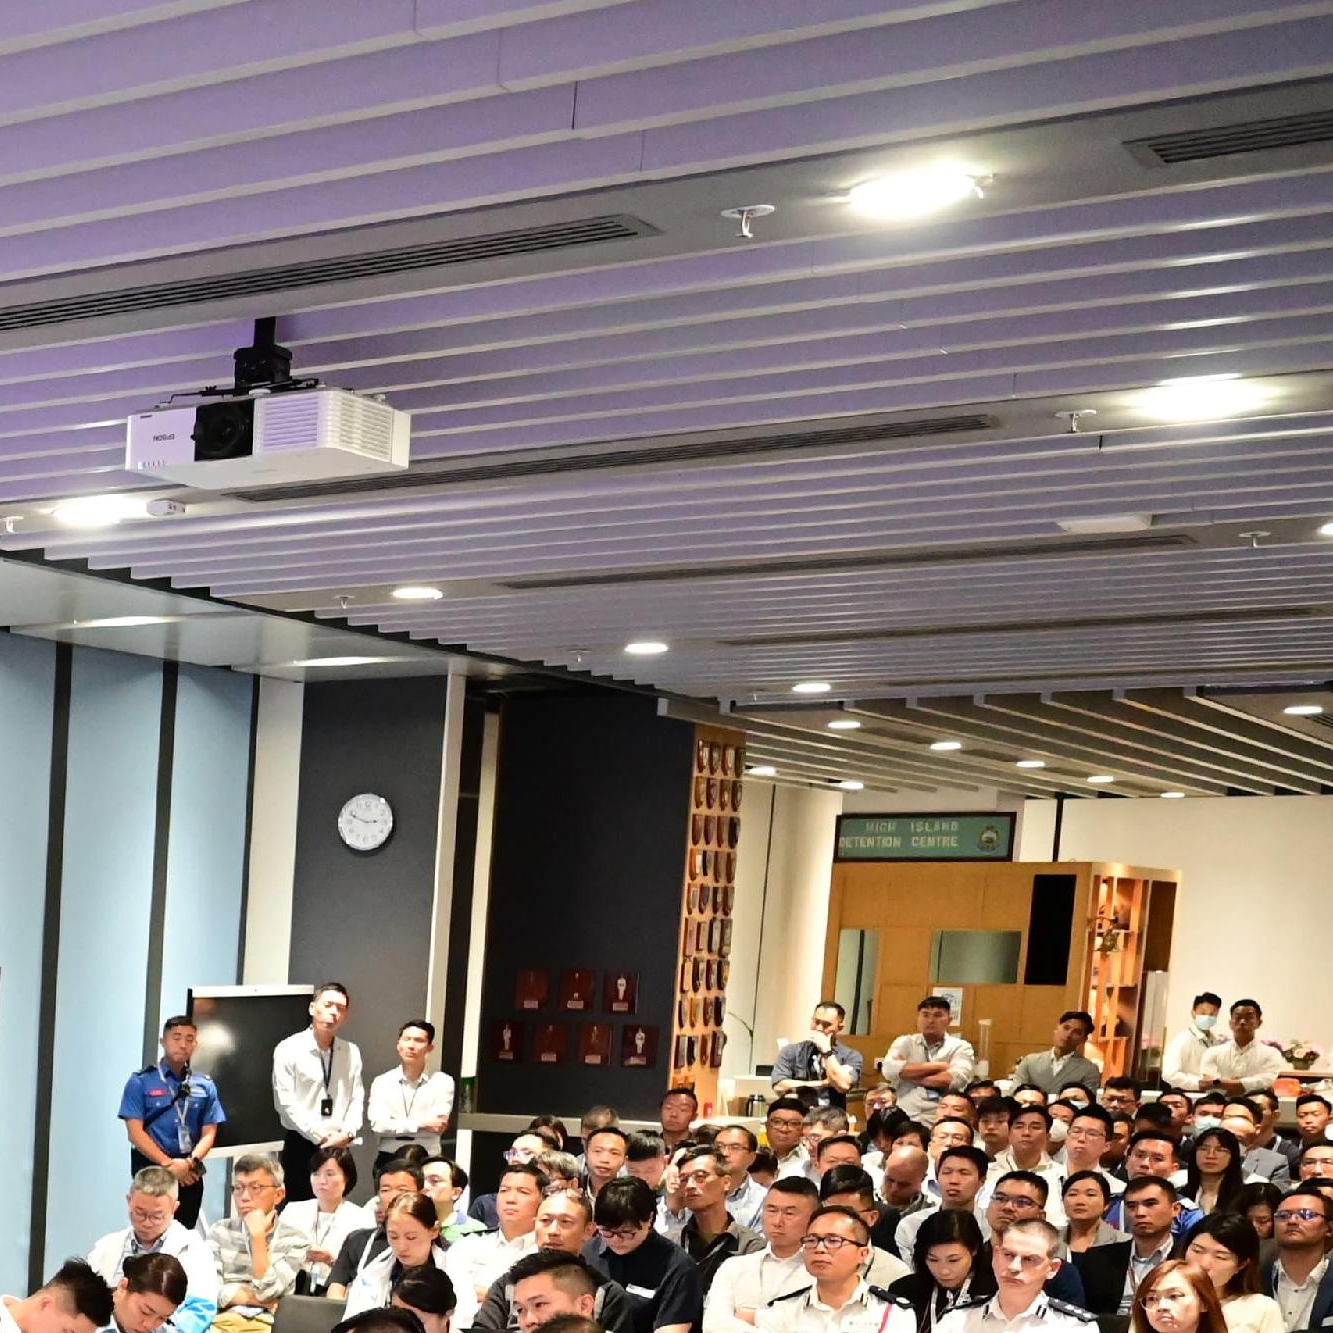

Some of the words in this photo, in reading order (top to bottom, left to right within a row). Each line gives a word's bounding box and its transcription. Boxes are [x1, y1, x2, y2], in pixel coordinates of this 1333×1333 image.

[910, 820, 959, 832] ISLAND
[839, 836, 902, 848] DETENTION
[912, 835, 959, 848] CENTRE
